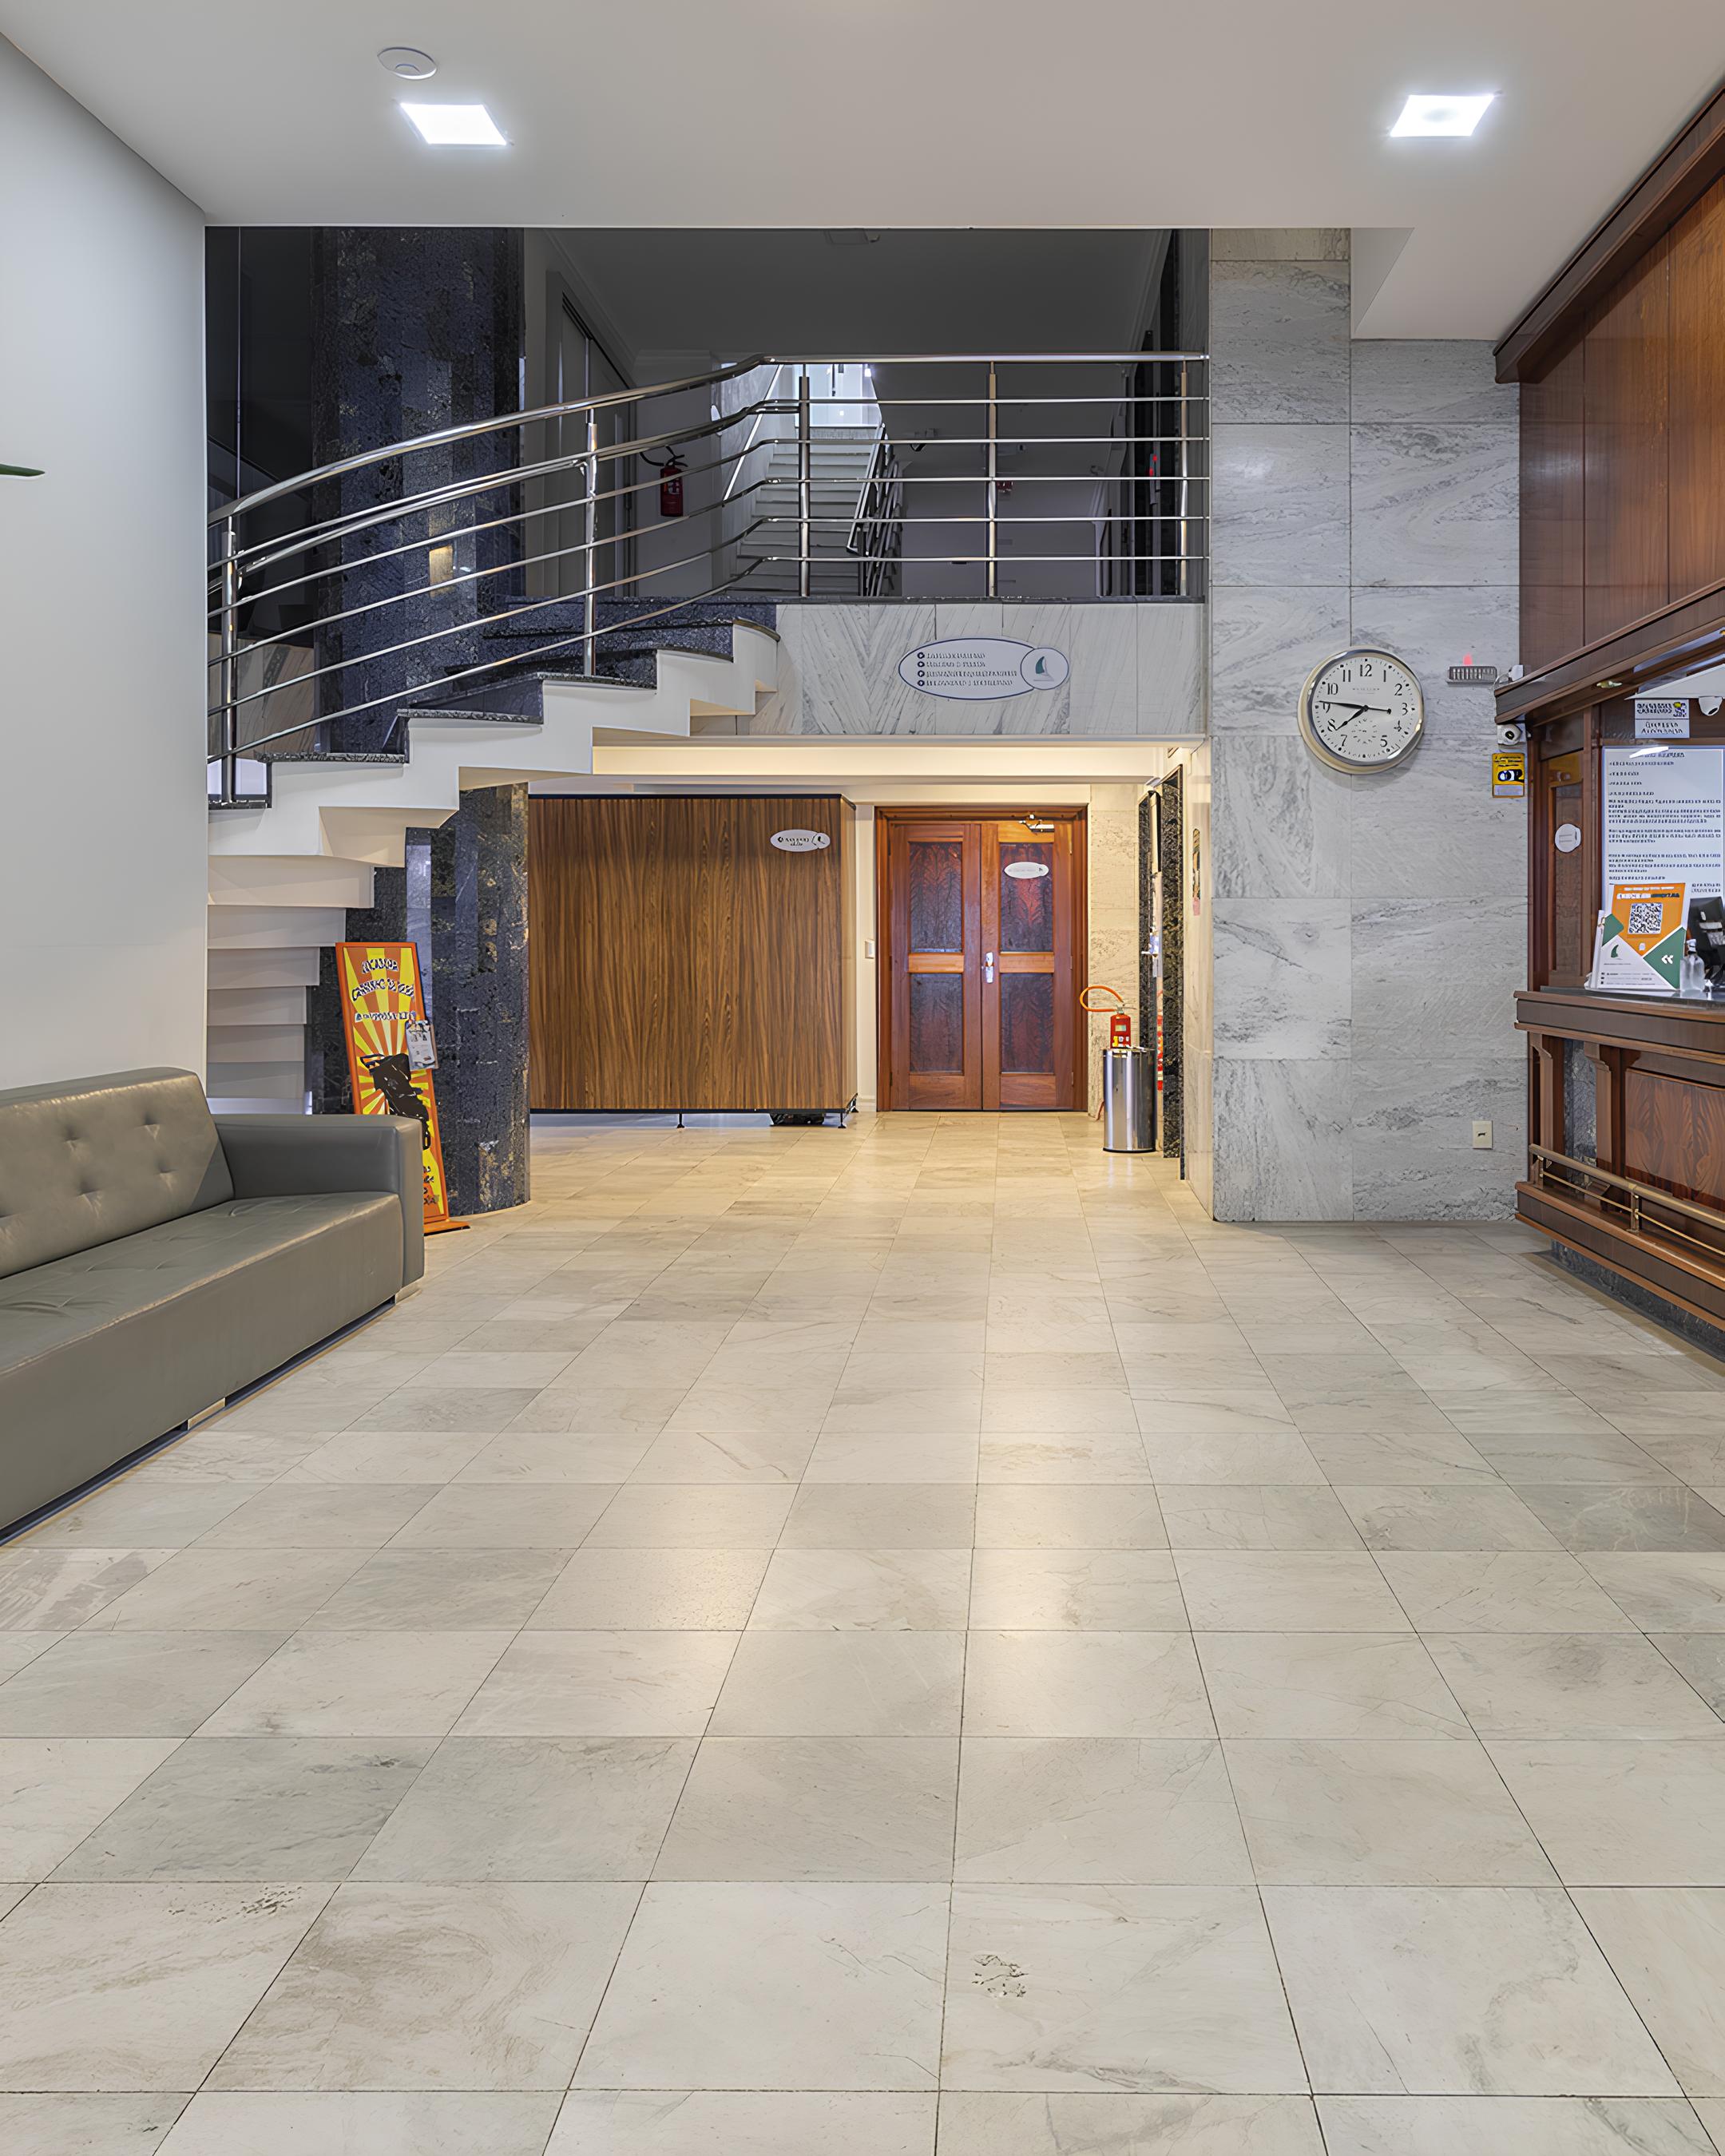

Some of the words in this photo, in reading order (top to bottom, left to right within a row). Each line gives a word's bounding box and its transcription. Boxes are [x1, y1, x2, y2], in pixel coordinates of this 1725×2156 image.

[1342, 669, 1351, 682] 11
[1359, 664, 1372, 677] 12
[1326, 683, 1338, 695] 10
[1394, 683, 1402, 696] 2
[1402, 702, 1408, 715] 3
[1340, 734, 1347, 747] 7
[1380, 735, 1388, 747] 5
